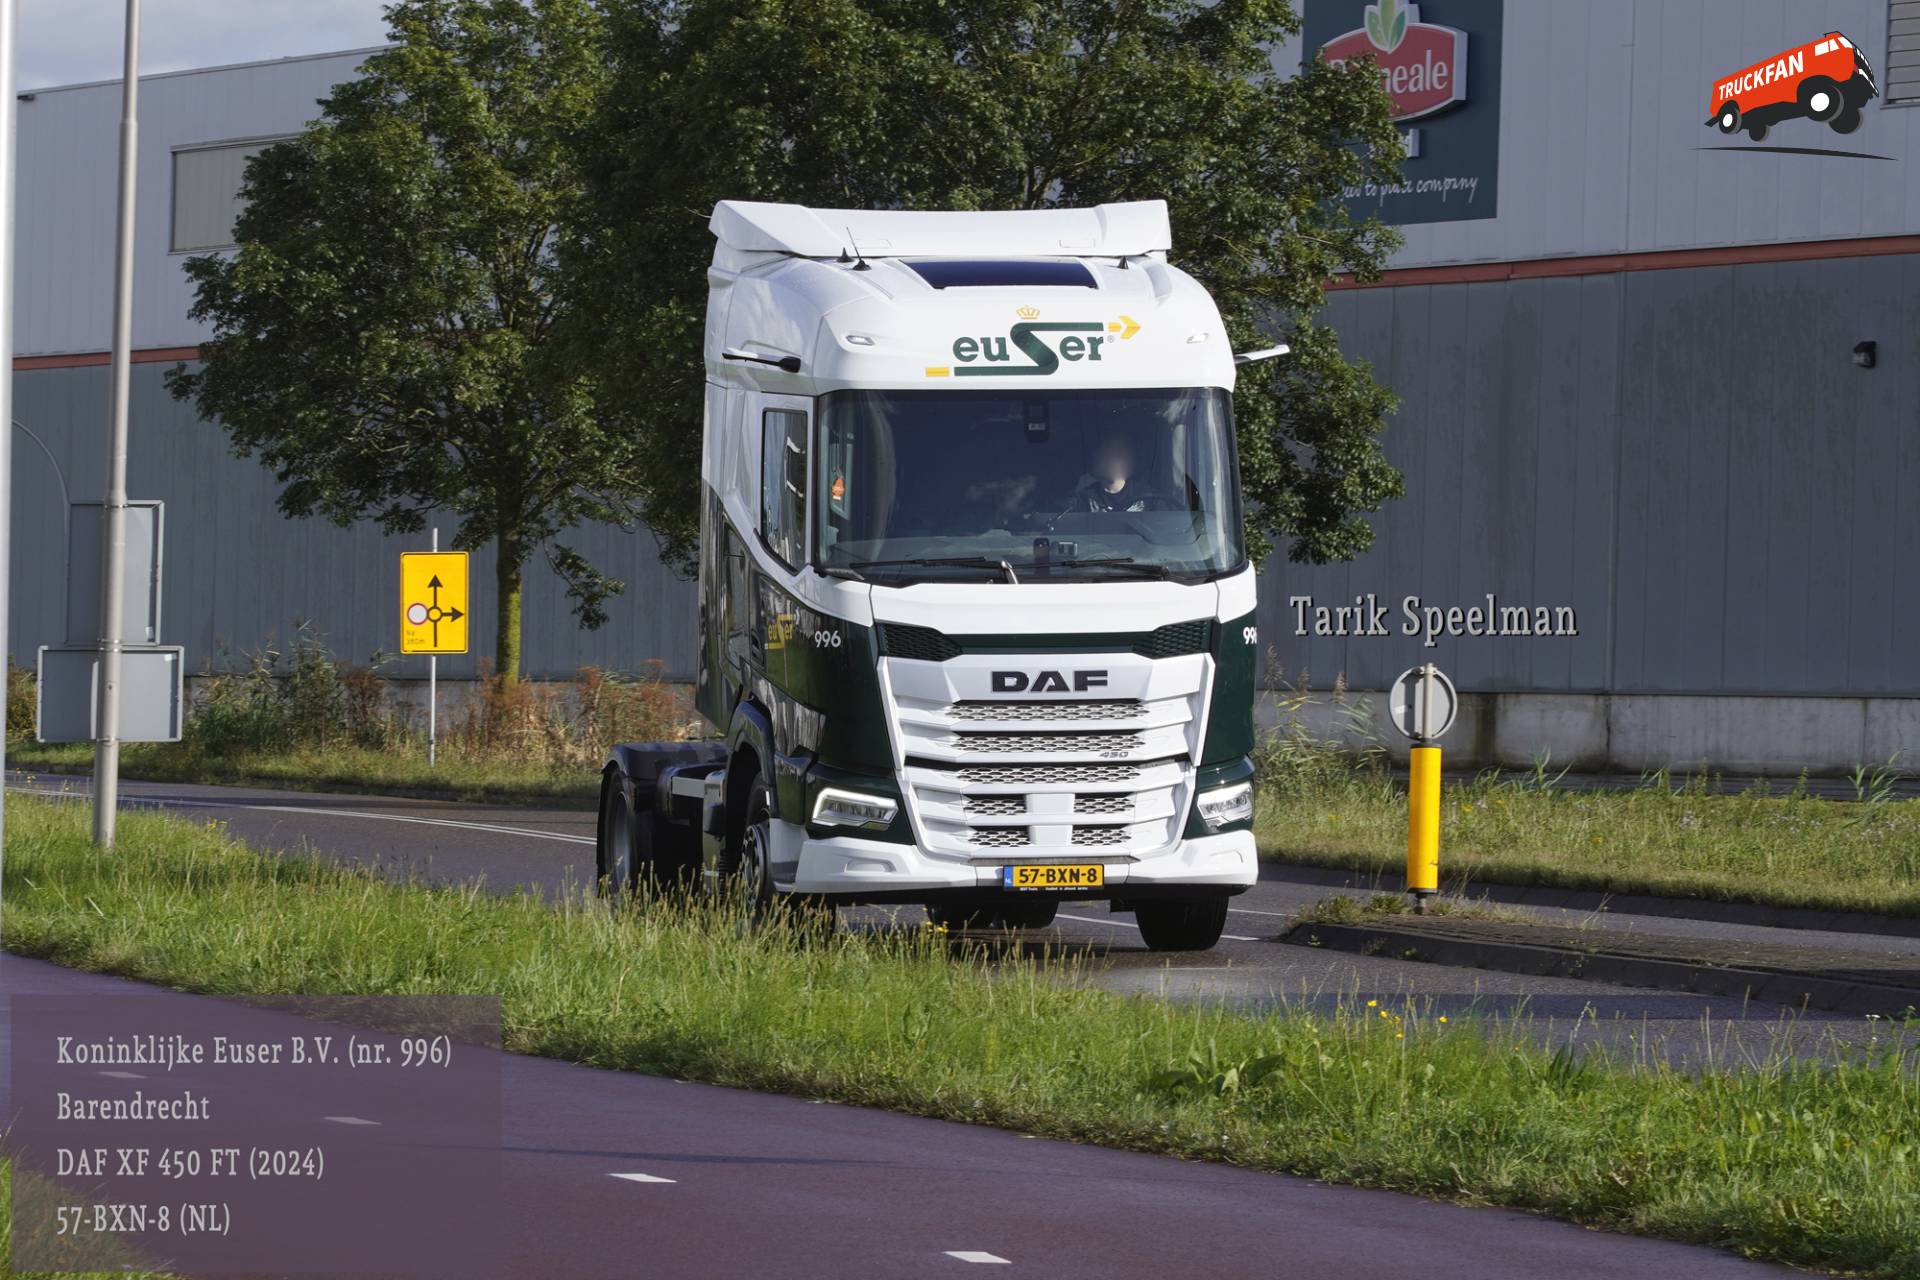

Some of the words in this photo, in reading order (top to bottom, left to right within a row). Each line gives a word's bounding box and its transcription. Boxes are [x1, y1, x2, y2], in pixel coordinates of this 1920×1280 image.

[1416, 177, 1479, 204] company
[814, 630, 842, 648] 996
[991, 670, 1109, 693] DAF
[1098, 751, 1129, 759] 450
[1018, 867, 1098, 884] 57-BXN-8
